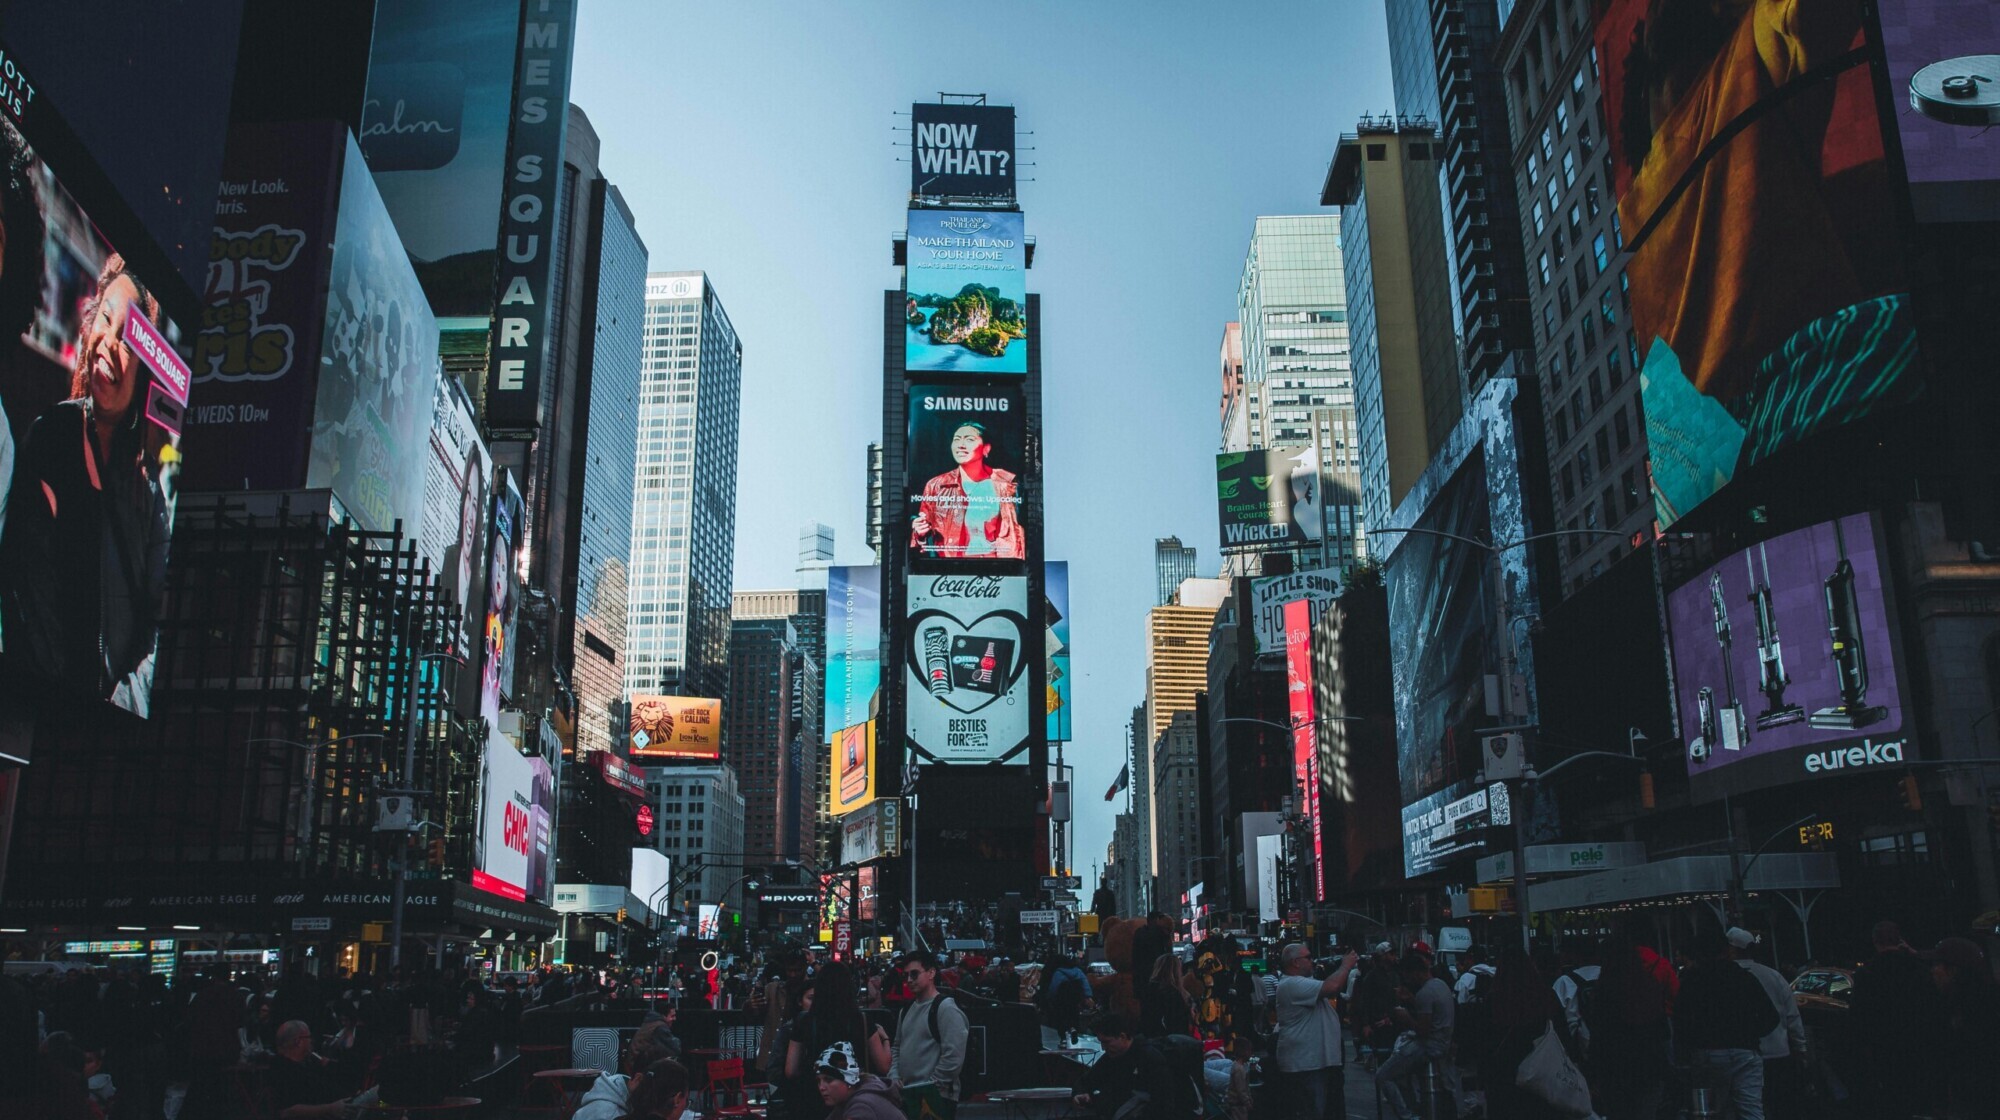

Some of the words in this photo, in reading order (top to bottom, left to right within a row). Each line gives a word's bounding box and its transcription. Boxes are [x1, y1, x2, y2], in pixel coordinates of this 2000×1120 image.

[917, 122, 978, 149] NOW
[917, 148, 1010, 176] WHAT?
[218, 180, 249, 197] New
[250, 177, 290, 195] Look.
[949, 216, 984, 224] THAILAND
[918, 237, 952, 247] MAKE
[954, 238, 1015, 248] THAILAND
[930, 249, 964, 260] YOUR
[966, 250, 1003, 261] HOME
[131, 317, 156, 358] TIMES
[155, 346, 187, 393] SQUARE
[924, 396, 1009, 412] SAMSUNG
[198, 404, 236, 425] WEDS
[910, 494, 937, 503] Movies
[939, 494, 956, 503] and
[985, 496, 1022, 504] Upscaled
[1227, 503, 1258, 513] Brains.
[1259, 500, 1286, 510] Heart.
[1237, 510, 1276, 520] Courage.
[1261, 575, 1304, 604] LITTLE
[1306, 574, 1339, 595] SHOP
[952, 655, 980, 665] OREO
[680, 707, 696, 716] PRIDE
[696, 708, 710, 716] ROCK
[685, 714, 710, 725] CALLING
[949, 718, 987, 732] BESTIES
[1804, 738, 1904, 773] eureka
[1428, 807, 1443, 828] MOVIE
[1448, 805, 1459, 819] PUBG
[1459, 798, 1474, 813] MOBILE
[503, 800, 530, 857] CHIC
[884, 801, 897, 857] HELLO!
[51, 897, 88, 909] EAGLE
[150, 895, 213, 906] AMERICAN
[219, 894, 257, 905] EAGLE
[272, 891, 305, 905] aerie
[322, 893, 392, 904] AMERICAN
[405, 894, 438, 905] AGLE
[557, 893, 566, 901] OUR
[837, 922, 852, 951] tkts
